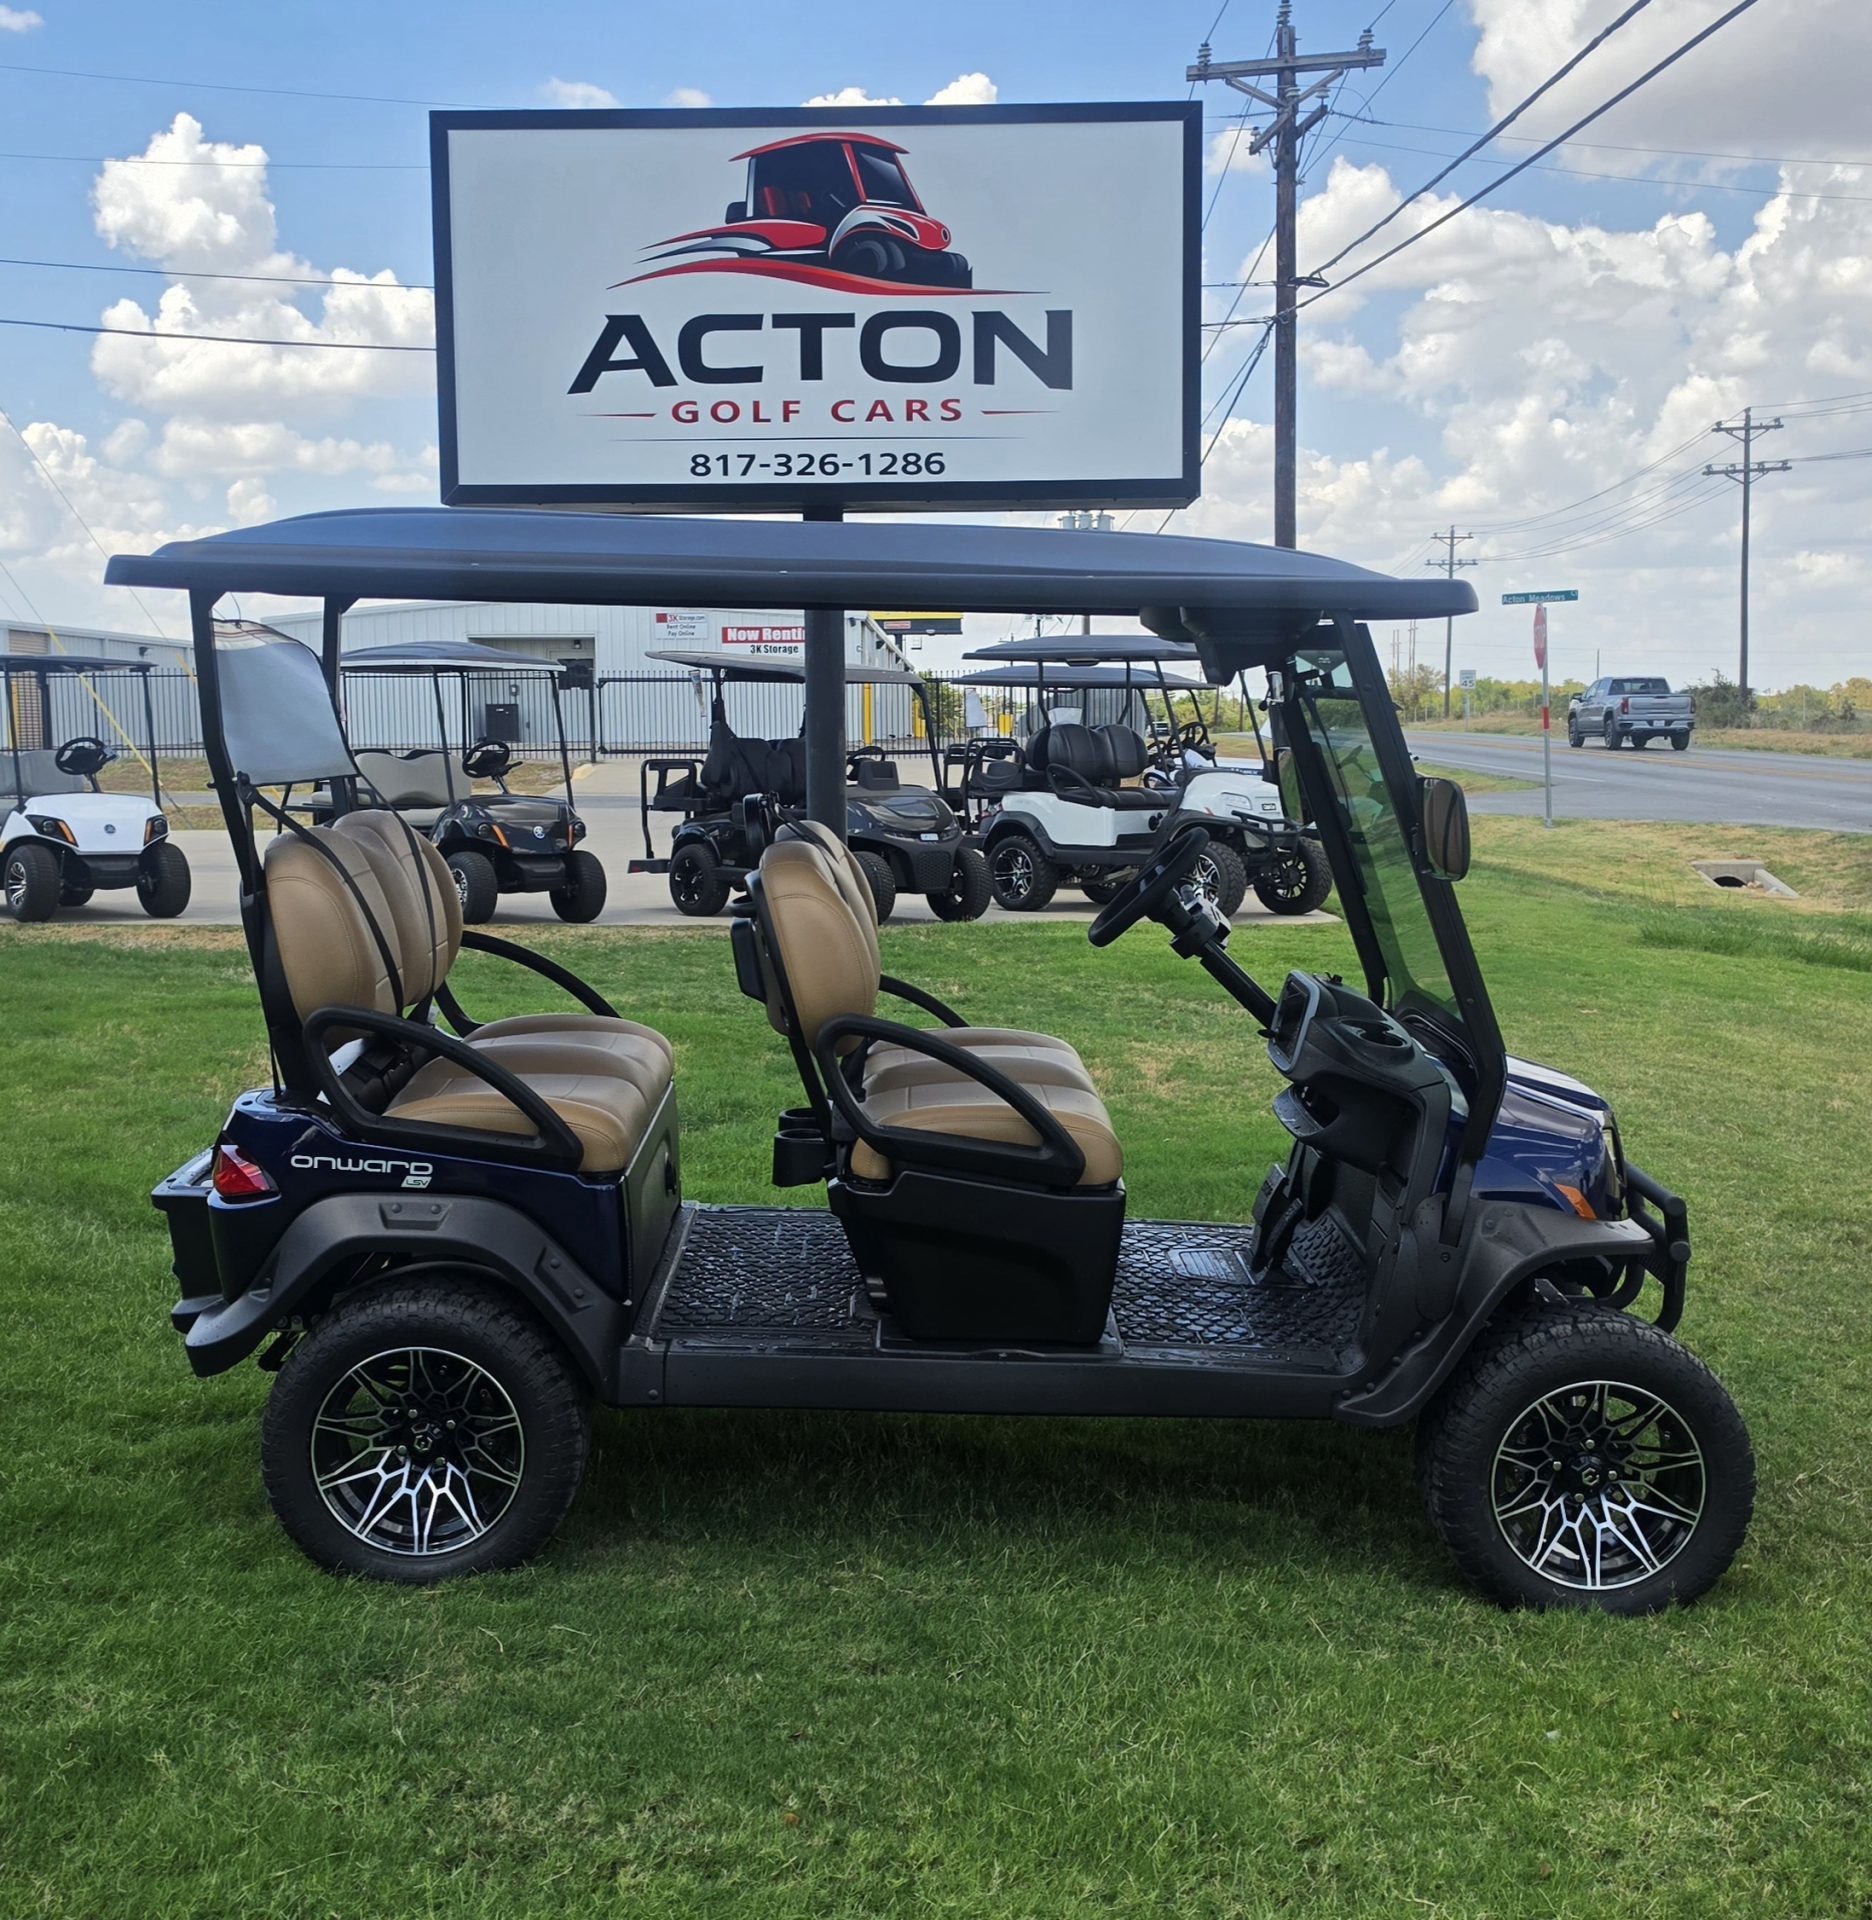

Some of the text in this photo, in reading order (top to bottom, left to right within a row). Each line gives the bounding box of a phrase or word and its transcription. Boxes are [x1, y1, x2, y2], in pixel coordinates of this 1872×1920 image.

[566, 309, 1073, 395] ACTON
[671, 398, 963, 424] GOLF CARS
[690, 452, 946, 476] 817-326-1286
[1503, 595, 1525, 604] Acton
[1528, 593, 1566, 602] Meadows
[727, 628, 760, 641] Now
[750, 645, 799, 654] 3K Storage
